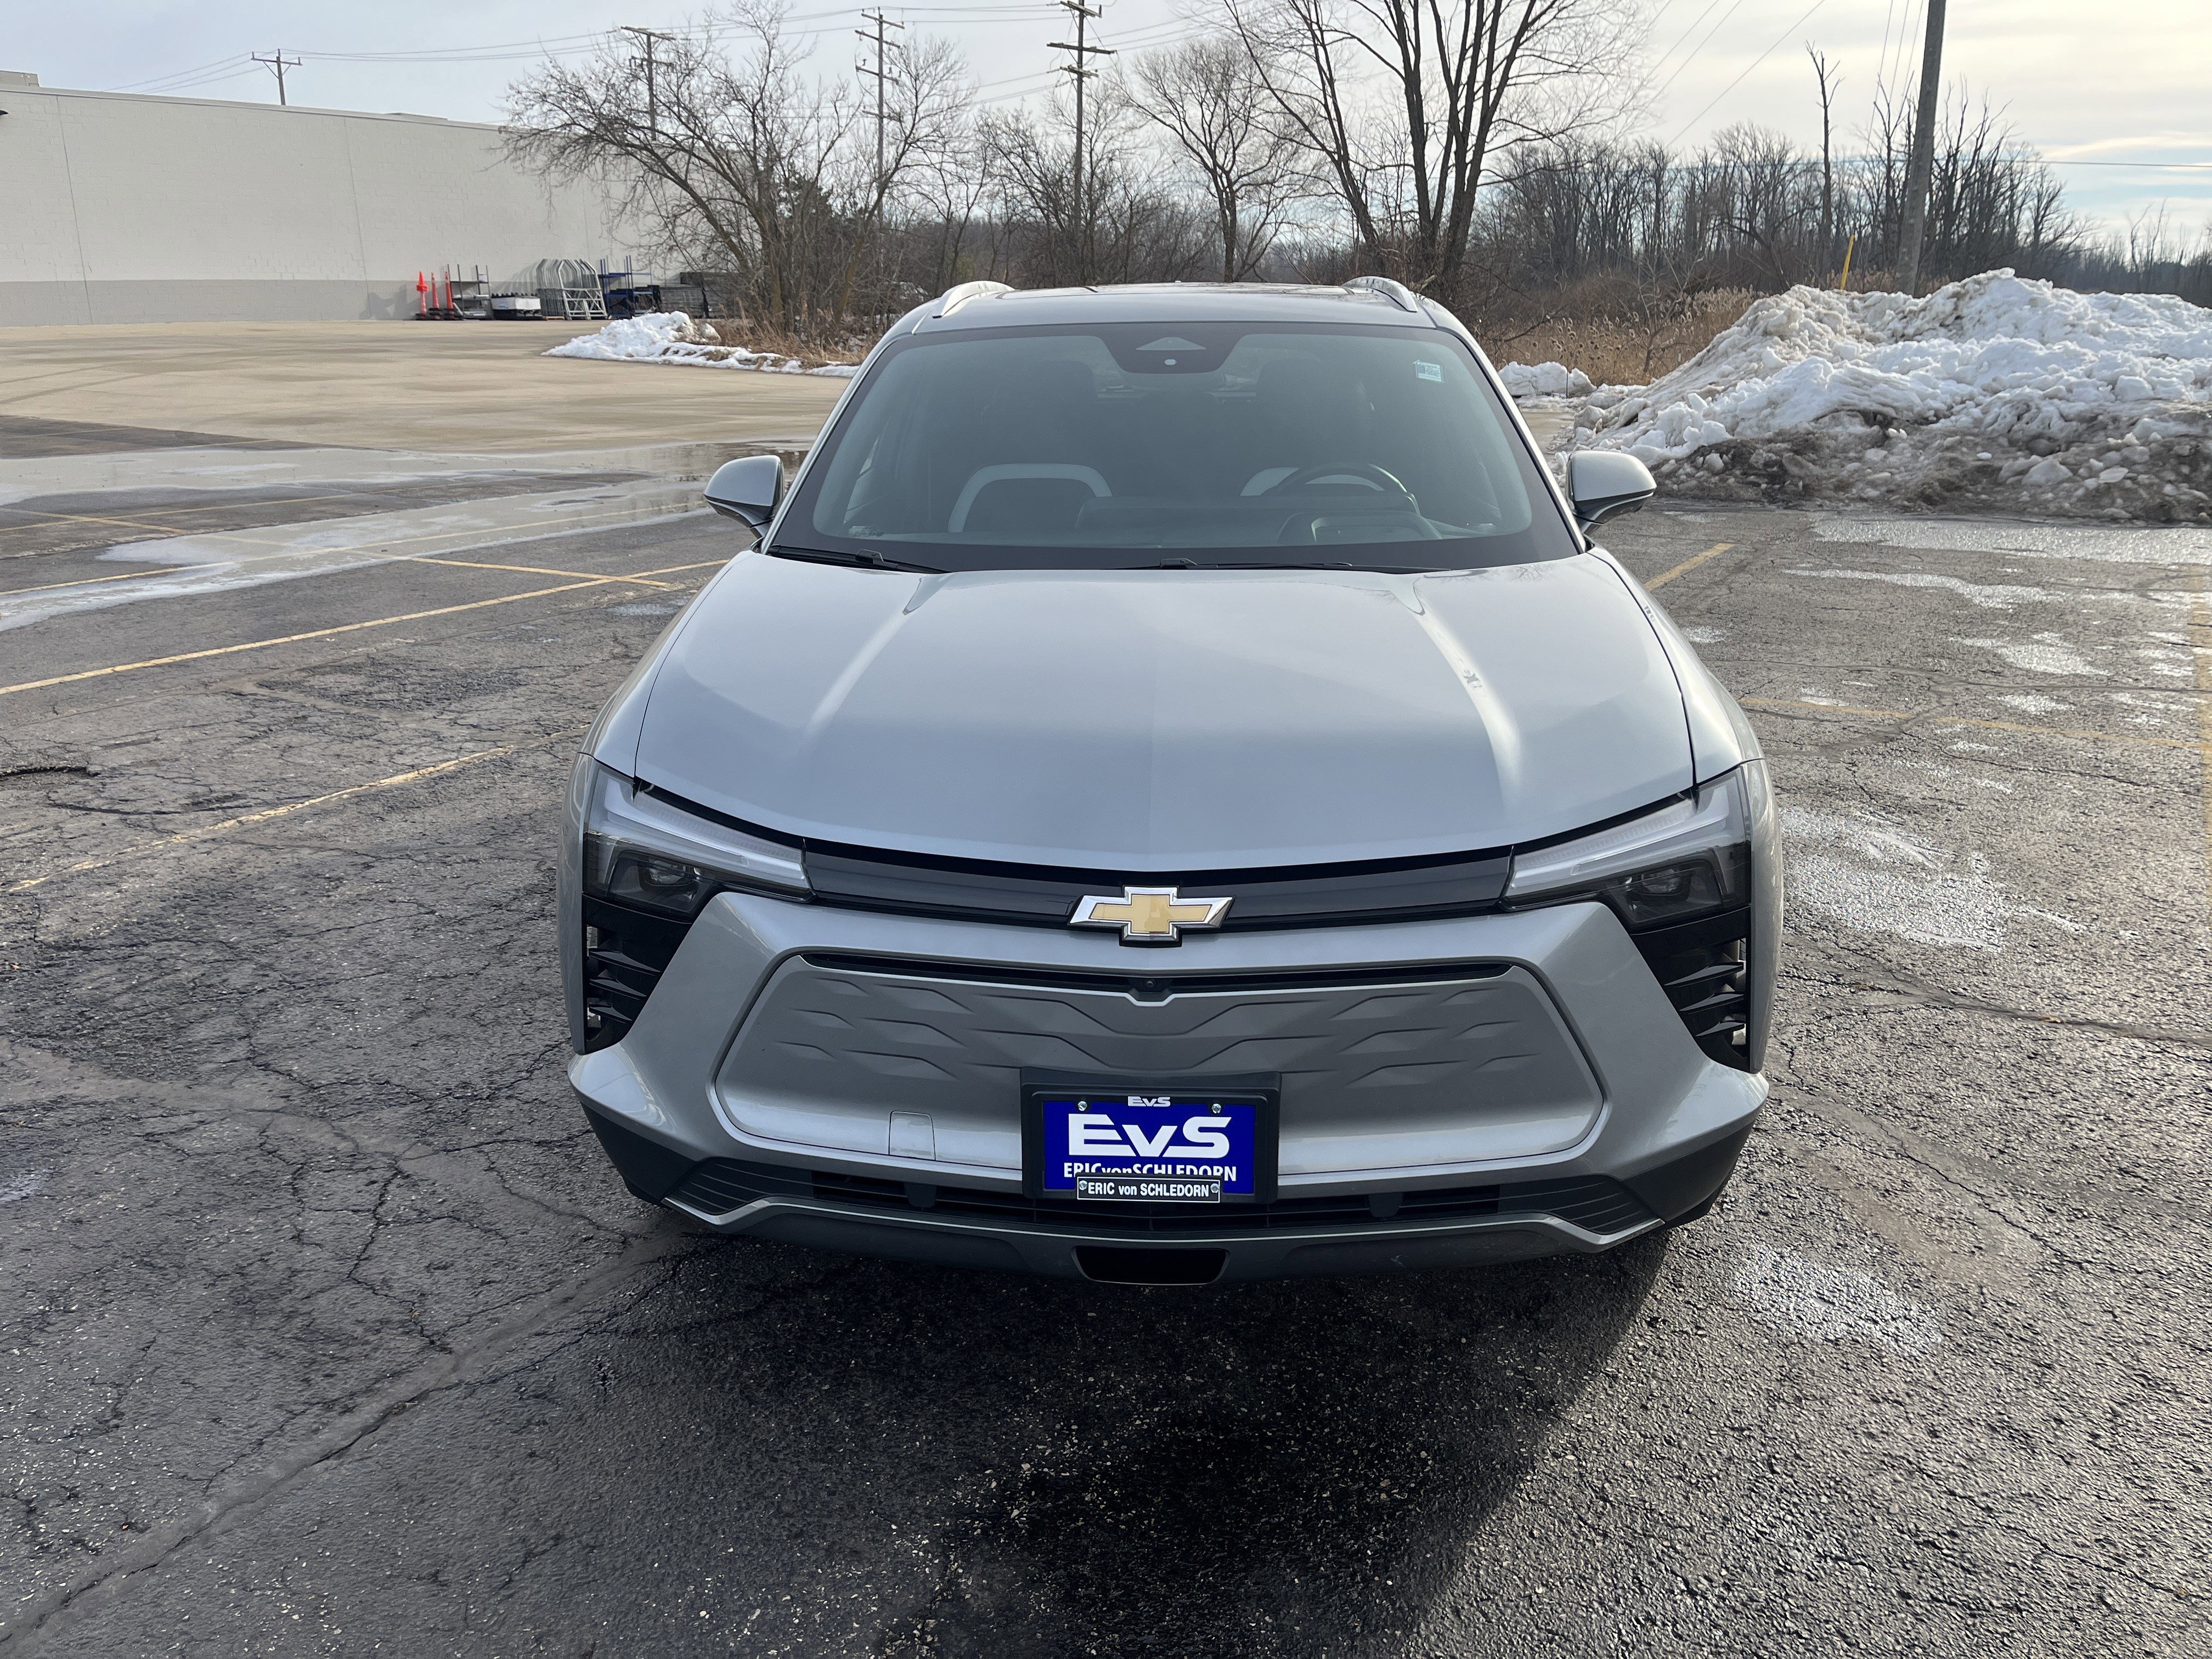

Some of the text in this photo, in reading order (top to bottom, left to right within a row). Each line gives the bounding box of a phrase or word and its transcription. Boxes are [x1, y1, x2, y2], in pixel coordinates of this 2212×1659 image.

[1088, 1182, 1209, 1197] ERIC von SCHLEDORN
